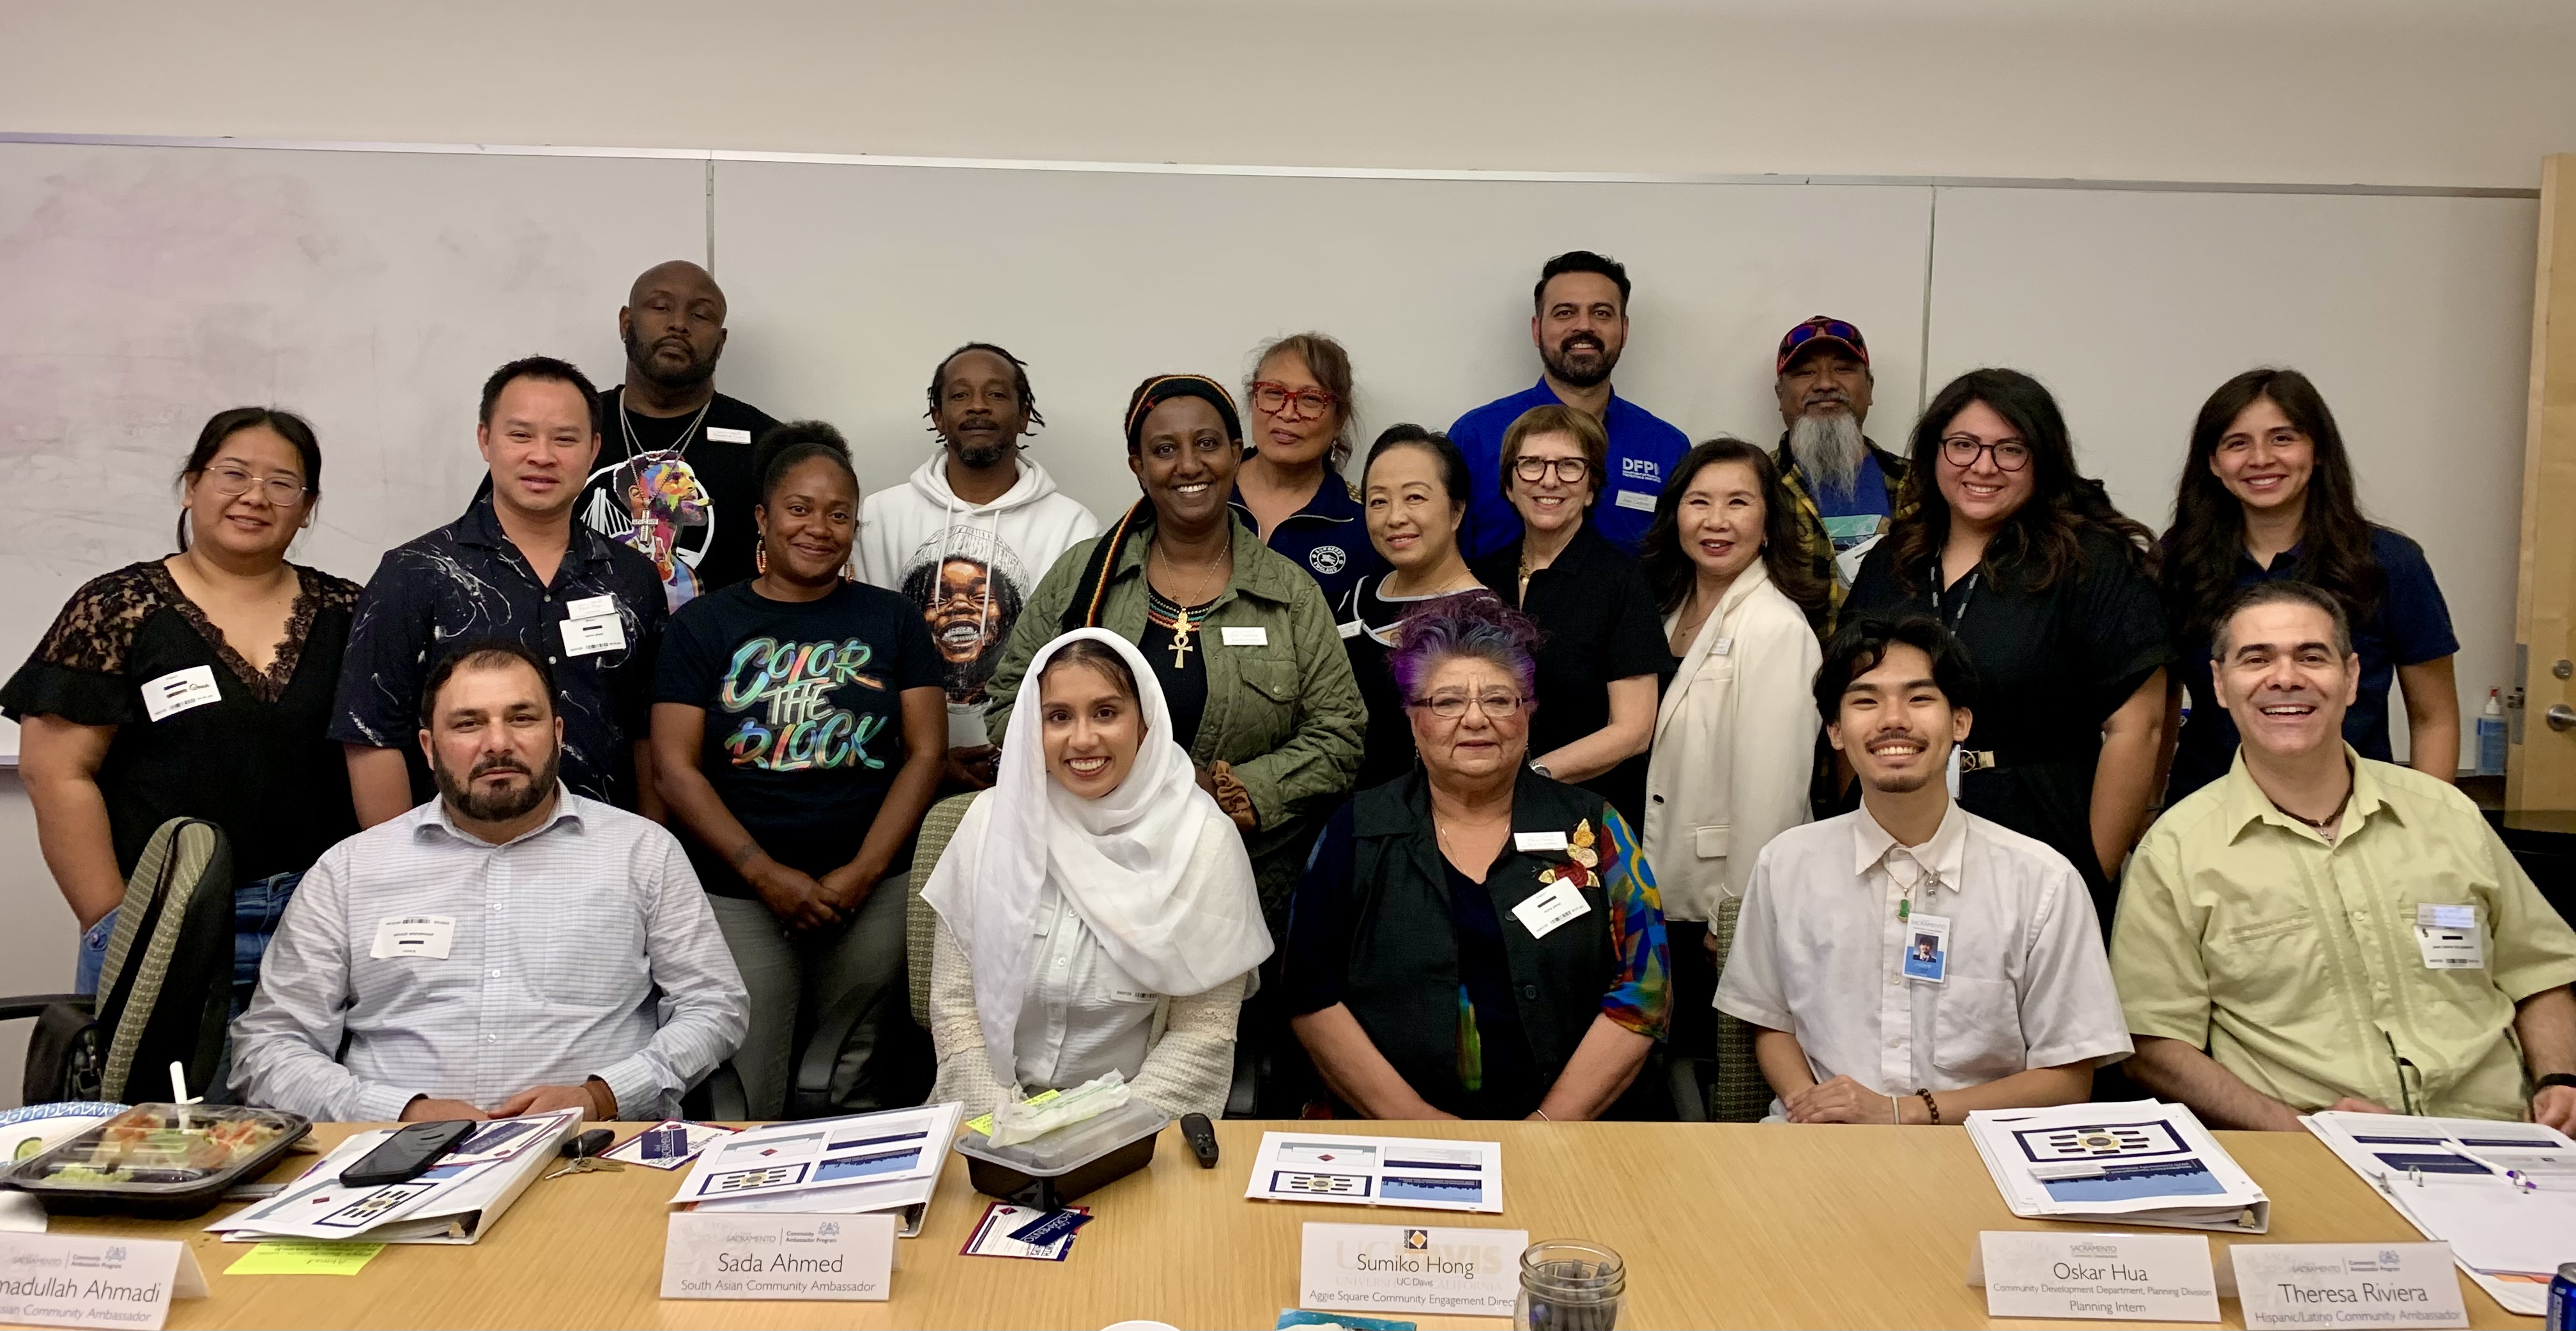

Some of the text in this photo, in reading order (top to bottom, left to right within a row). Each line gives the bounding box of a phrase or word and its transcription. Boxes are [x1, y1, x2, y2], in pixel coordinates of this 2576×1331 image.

[1313, 561, 1337, 573] ENGLAND
[758, 681, 837, 726] THE
[723, 712, 888, 772] BLOCK
[726, 1235, 776, 1243] SACRAMENTO
[717, 1252, 843, 1273] Sada Ahmed
[1357, 1253, 1475, 1280] Sumiko Hong
[2053, 1262, 2149, 1281] Oskar Hua
[681, 1279, 876, 1293] South Asian Community Ambassador
[1397, 1277, 1434, 1287] UC Davis
[1993, 1283, 2039, 1294] Community
[2041, 1284, 2094, 1295] Development
[2147, 1286, 2179, 1298] Planning
[2181, 1287, 2212, 1296] Division
[82, 1279, 162, 1303] Ahmadi
[1309, 1290, 1335, 1303] Aggie
[1338, 1291, 1369, 1304] Square
[1372, 1291, 1427, 1307] Community
[1429, 1294, 1485, 1307] Engagement
[2277, 1282, 2429, 1304] Theresa Riviera
[23, 1304, 84, 1321] Community
[86, 1308, 152, 1322] Ambassador
[2069, 1300, 2147, 1315] Planning Intern
[2255, 1311, 2462, 1325] Hispanic/Latino Community Ambassador
